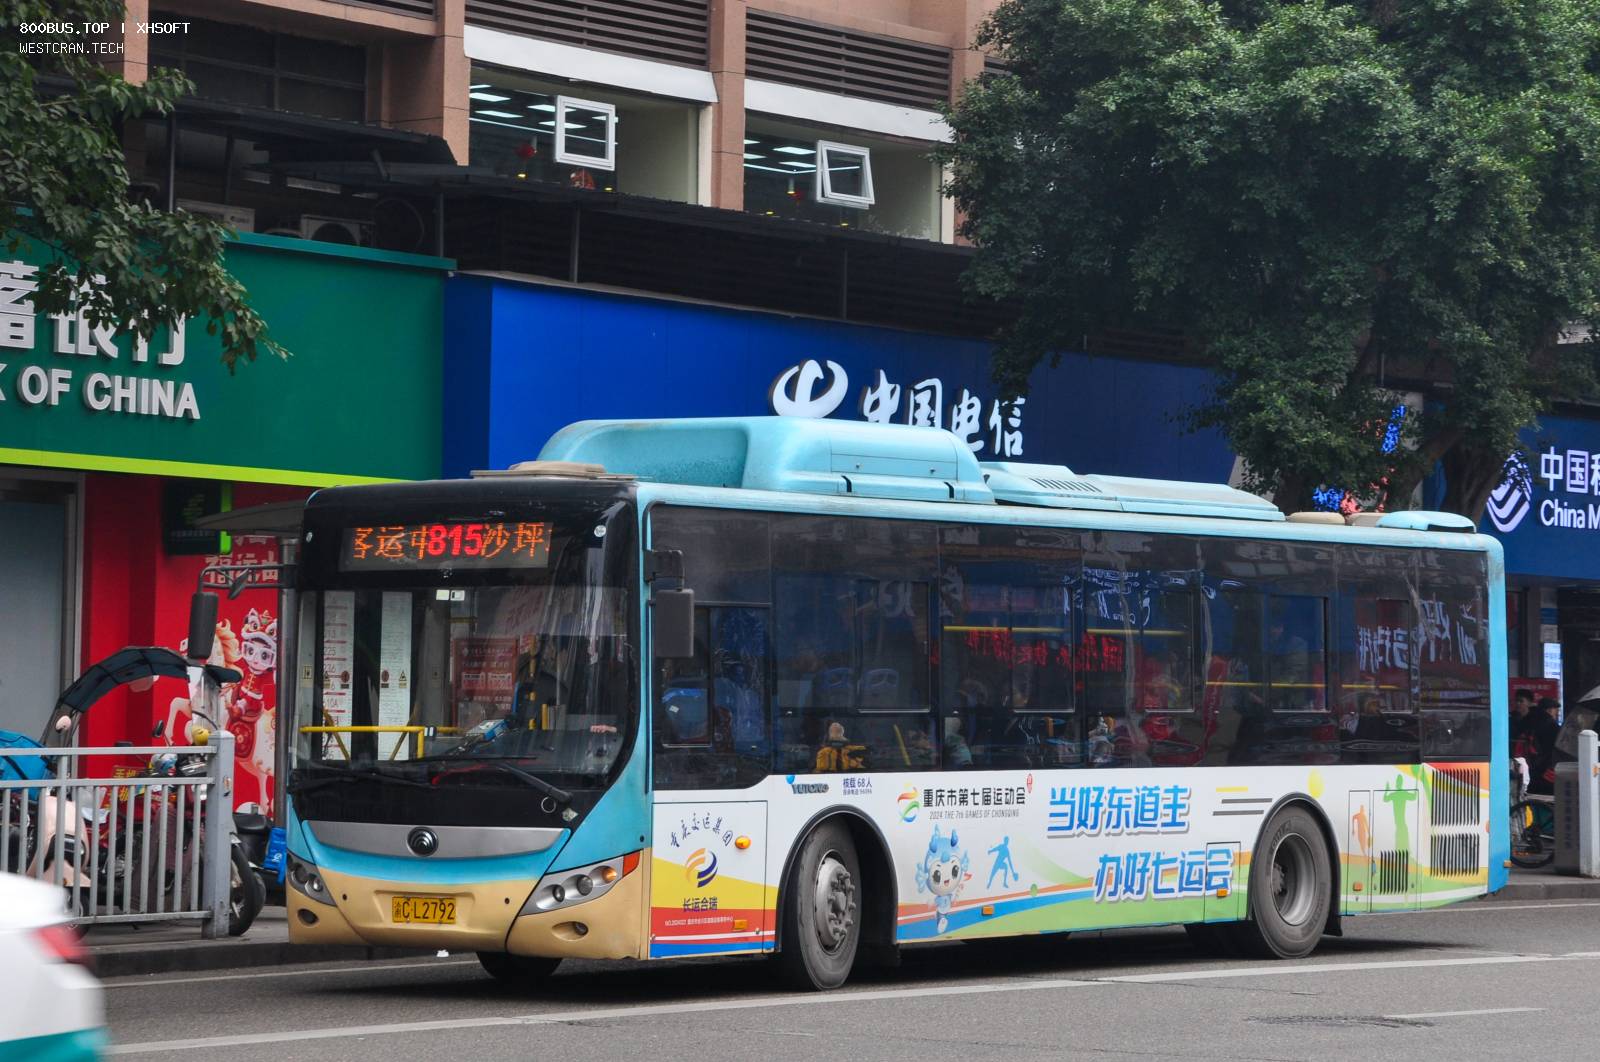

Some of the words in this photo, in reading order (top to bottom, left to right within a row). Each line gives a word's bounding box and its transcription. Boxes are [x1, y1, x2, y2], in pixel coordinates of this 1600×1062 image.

[18, 365, 73, 406] OF
[83, 372, 201, 420] CHINA
[862, 368, 1026, 458] 中国电信
[1540, 499, 1586, 529] China
[427, 524, 484, 556] 815
[923, 786, 1026, 808] 重庆市第七届运动会
[944, 810, 955, 820] THE
[965, 809, 983, 819] GAMES
[1046, 784, 1190, 833] 当好东道主
[1094, 848, 1234, 899] 办好七运会
